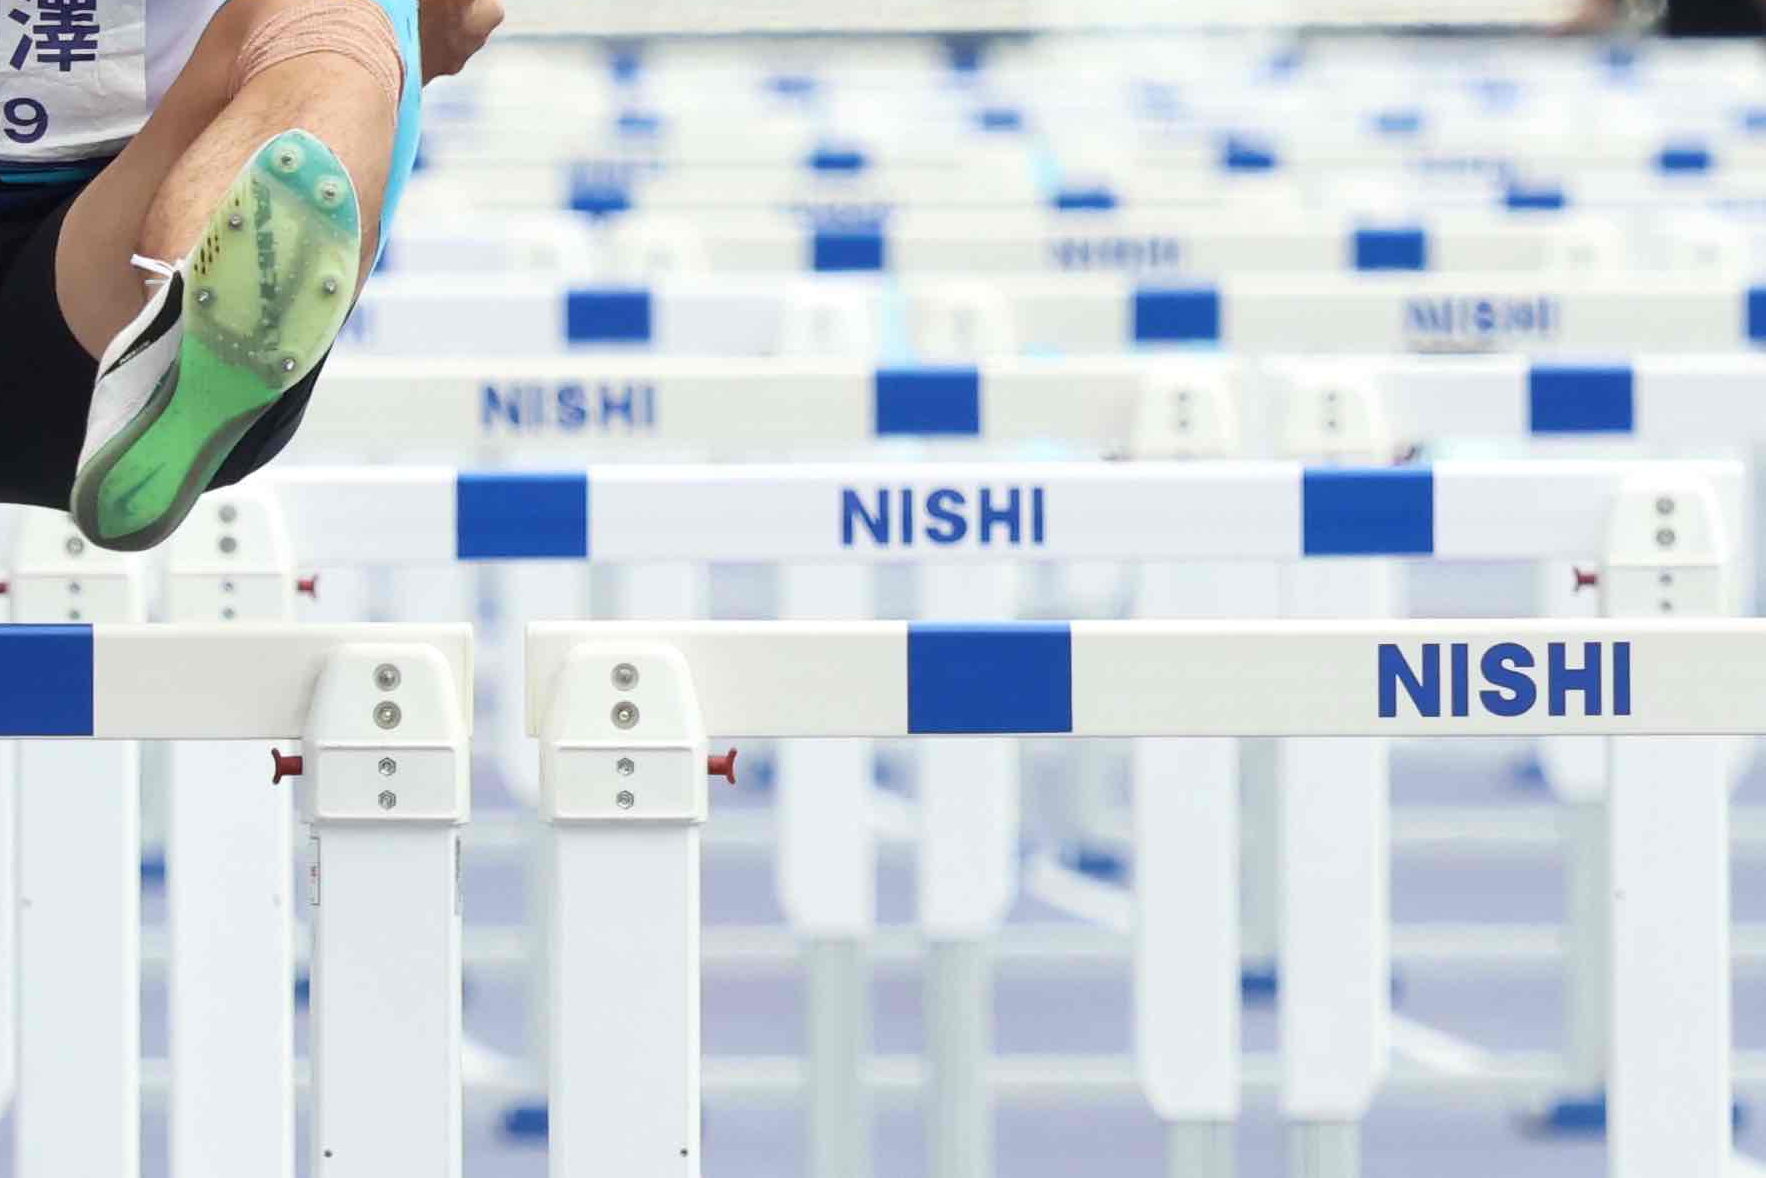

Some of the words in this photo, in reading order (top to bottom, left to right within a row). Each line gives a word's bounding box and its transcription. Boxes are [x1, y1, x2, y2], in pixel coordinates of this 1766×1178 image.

[481, 383, 656, 430] NISHI
[840, 487, 1045, 545] NISHI
[1378, 642, 1631, 717] NISHI
